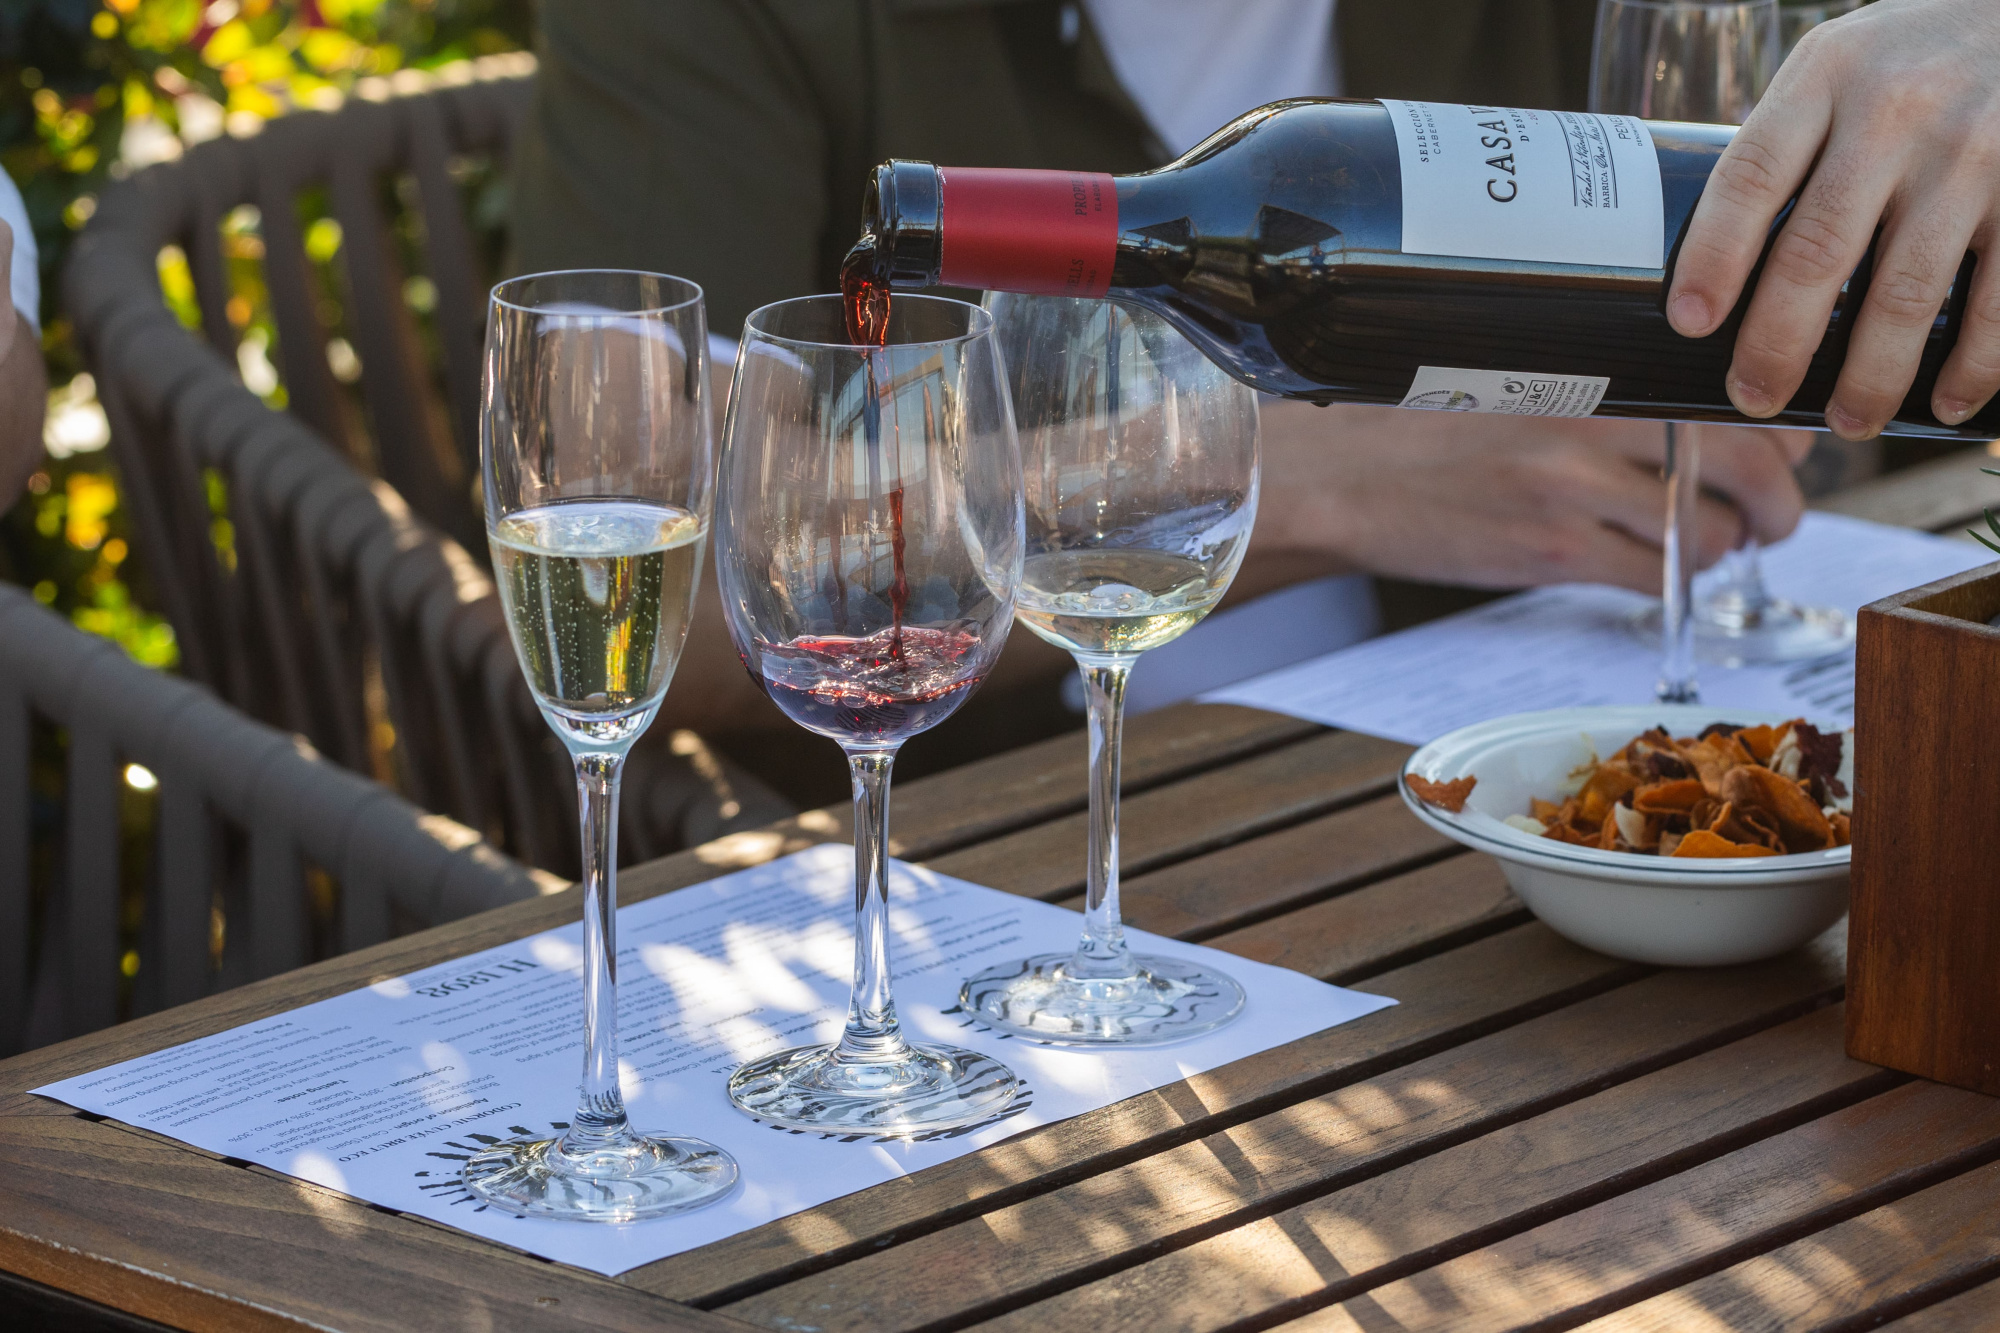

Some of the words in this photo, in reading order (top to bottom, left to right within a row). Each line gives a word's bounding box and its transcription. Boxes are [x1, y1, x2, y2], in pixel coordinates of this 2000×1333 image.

[1422, 110, 1441, 155] CABERNET
[1477, 119, 1518, 203] CASA
[1574, 158, 1590, 171] de
[1526, 383, 1546, 406] J&C
[496, 958, 539, 973] H
[415, 970, 502, 997] 1898
[389, 1065, 454, 1087] Composition
[305, 1079, 348, 1093] Tasting
[273, 1091, 307, 1103] notes:
[452, 1102, 521, 1124] CODORNIU
[393, 1117, 424, 1129] origin
[360, 1129, 389, 1139] Cava
[404, 1123, 451, 1139] CUVÉE
[368, 1137, 406, 1152] BRUT
[337, 1150, 369, 1162] ECO
